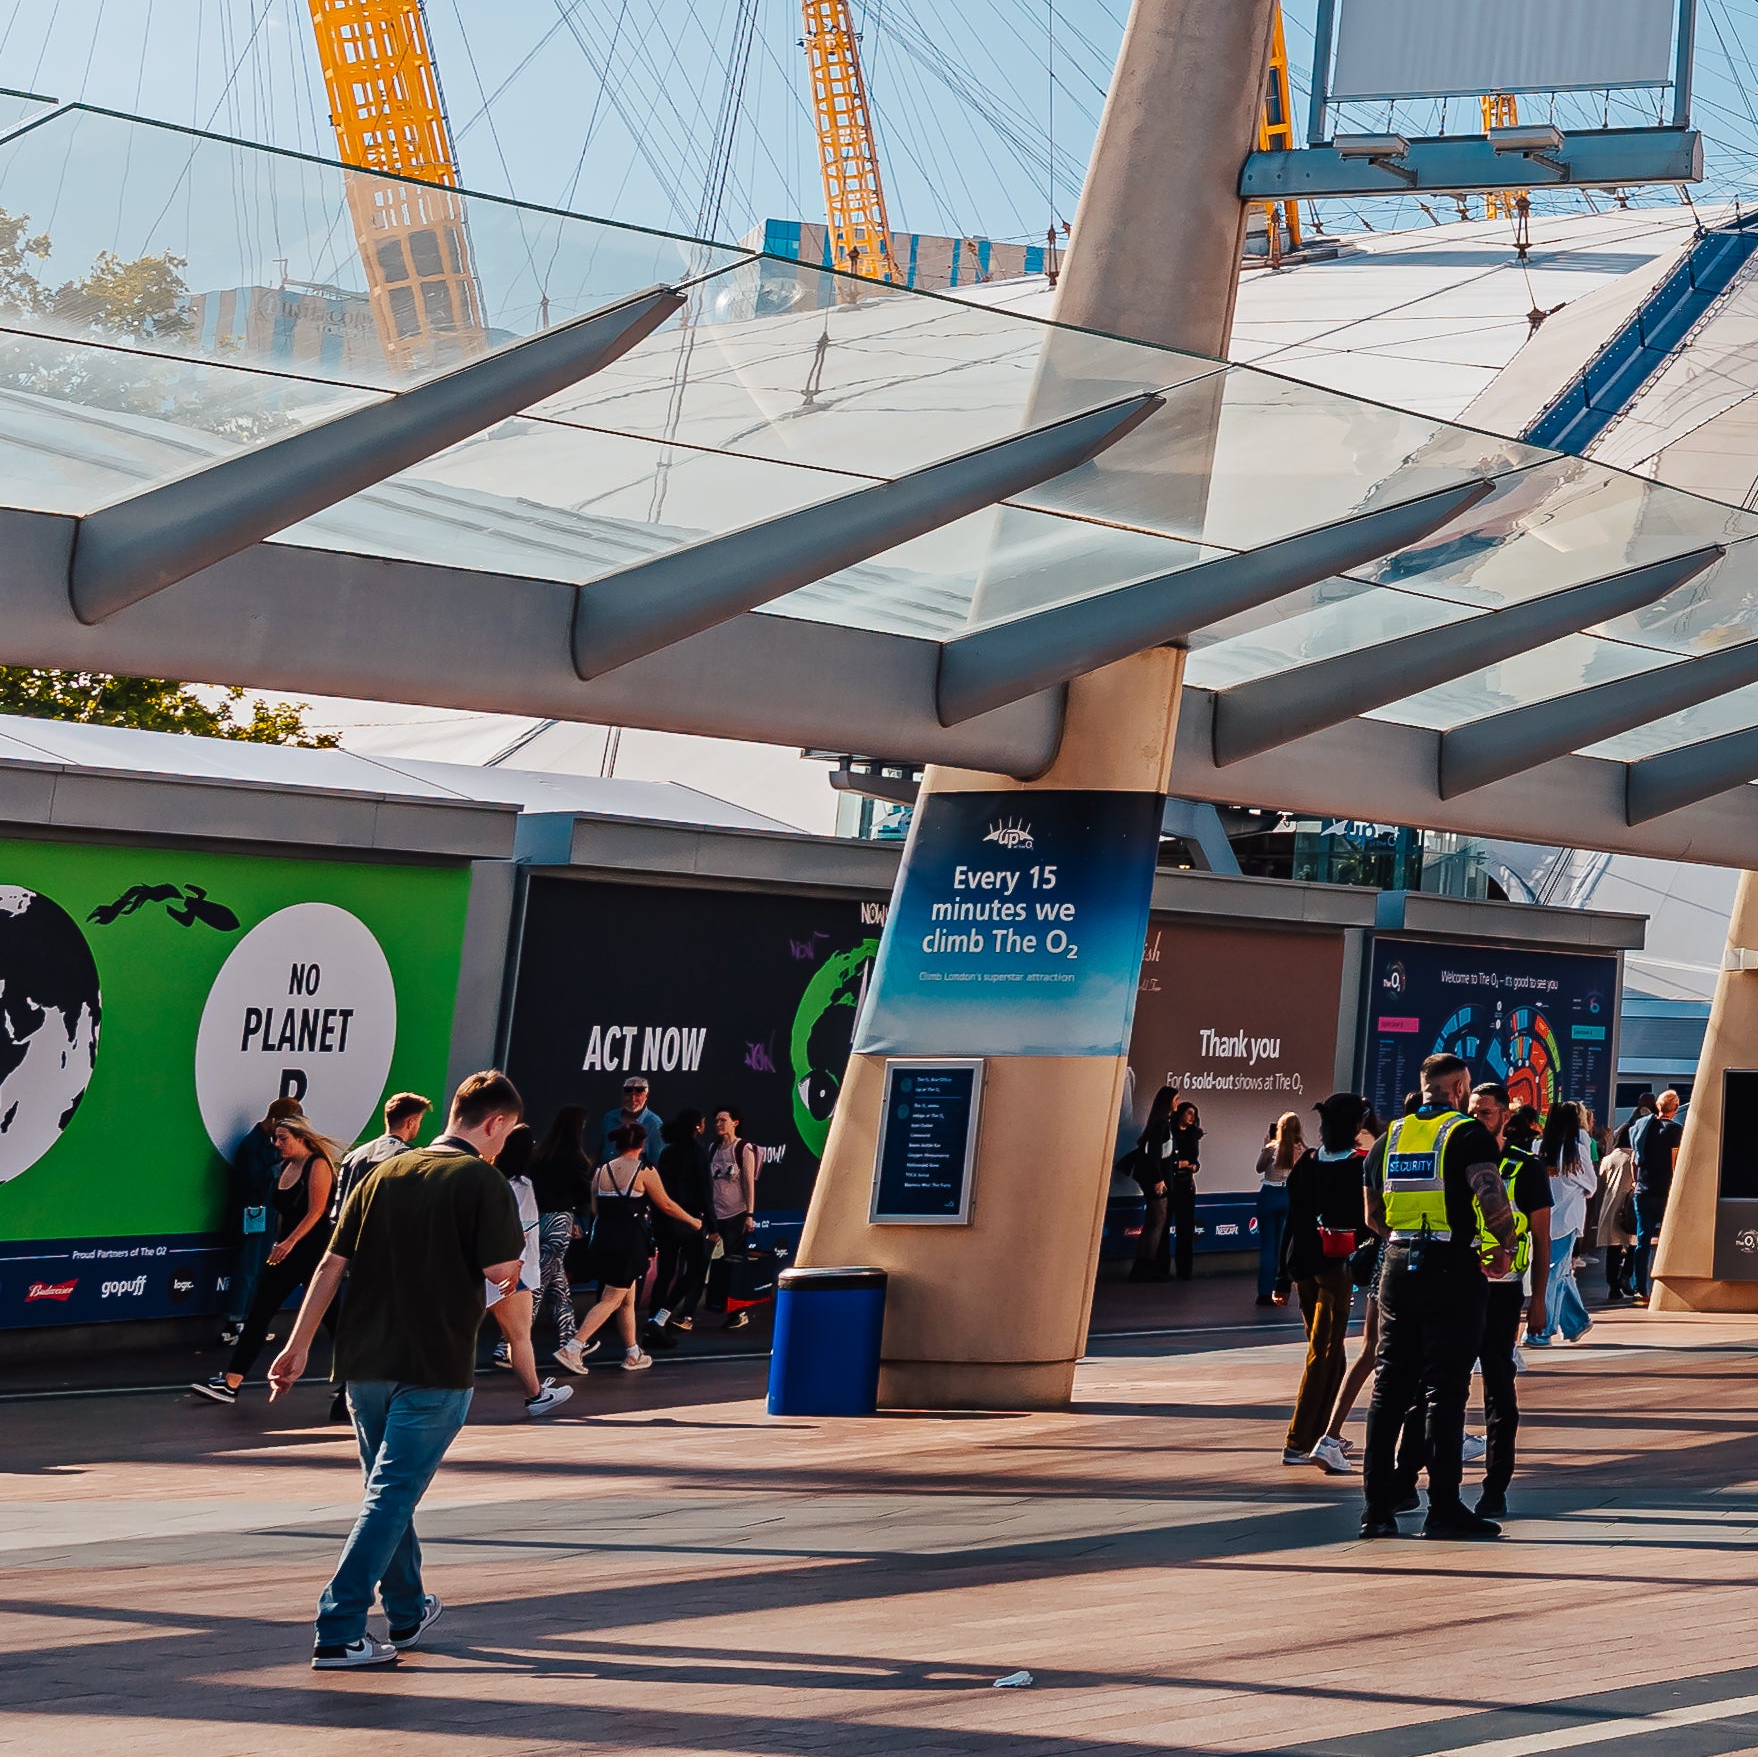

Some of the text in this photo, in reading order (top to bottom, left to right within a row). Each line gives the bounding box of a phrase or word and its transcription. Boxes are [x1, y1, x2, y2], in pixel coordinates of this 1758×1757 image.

[953, 865, 1058, 895] Every 15
[931, 897, 1076, 922] minutes we
[922, 928, 1078, 959] climb The O2
[288, 963, 321, 996] NO
[944, 972, 982, 981] London's
[983, 973, 1024, 983] superstar
[1026, 972, 1075, 982] attraction
[1441, 970, 1470, 985] Welcome
[1470, 973, 1478, 985] to
[1479, 972, 1490, 986] The
[1513, 975, 1529, 991] good
[1529, 977, 1537, 989] to
[1536, 978, 1547, 990] see
[1546, 979, 1559, 993] you
[240, 1007, 354, 1053] PLANET
[582, 1026, 707, 1072] ACT NOW
[1200, 1028, 1280, 1065] Thank you
[1166, 1072, 1183, 1088] For
[1183, 1072, 1191, 1089] 6
[1192, 1071, 1233, 1090] sold-out
[1234, 1073, 1263, 1090] shows
[1264, 1074, 1273, 1090] at
[1274, 1073, 1291, 1090] The
[1389, 1160, 1433, 1173] SECURITY
[72, 1246, 167, 1260] Proud Partners of The O2
[28, 1284, 75, 1298] Budweiser
[101, 1275, 147, 1298] gopuff
